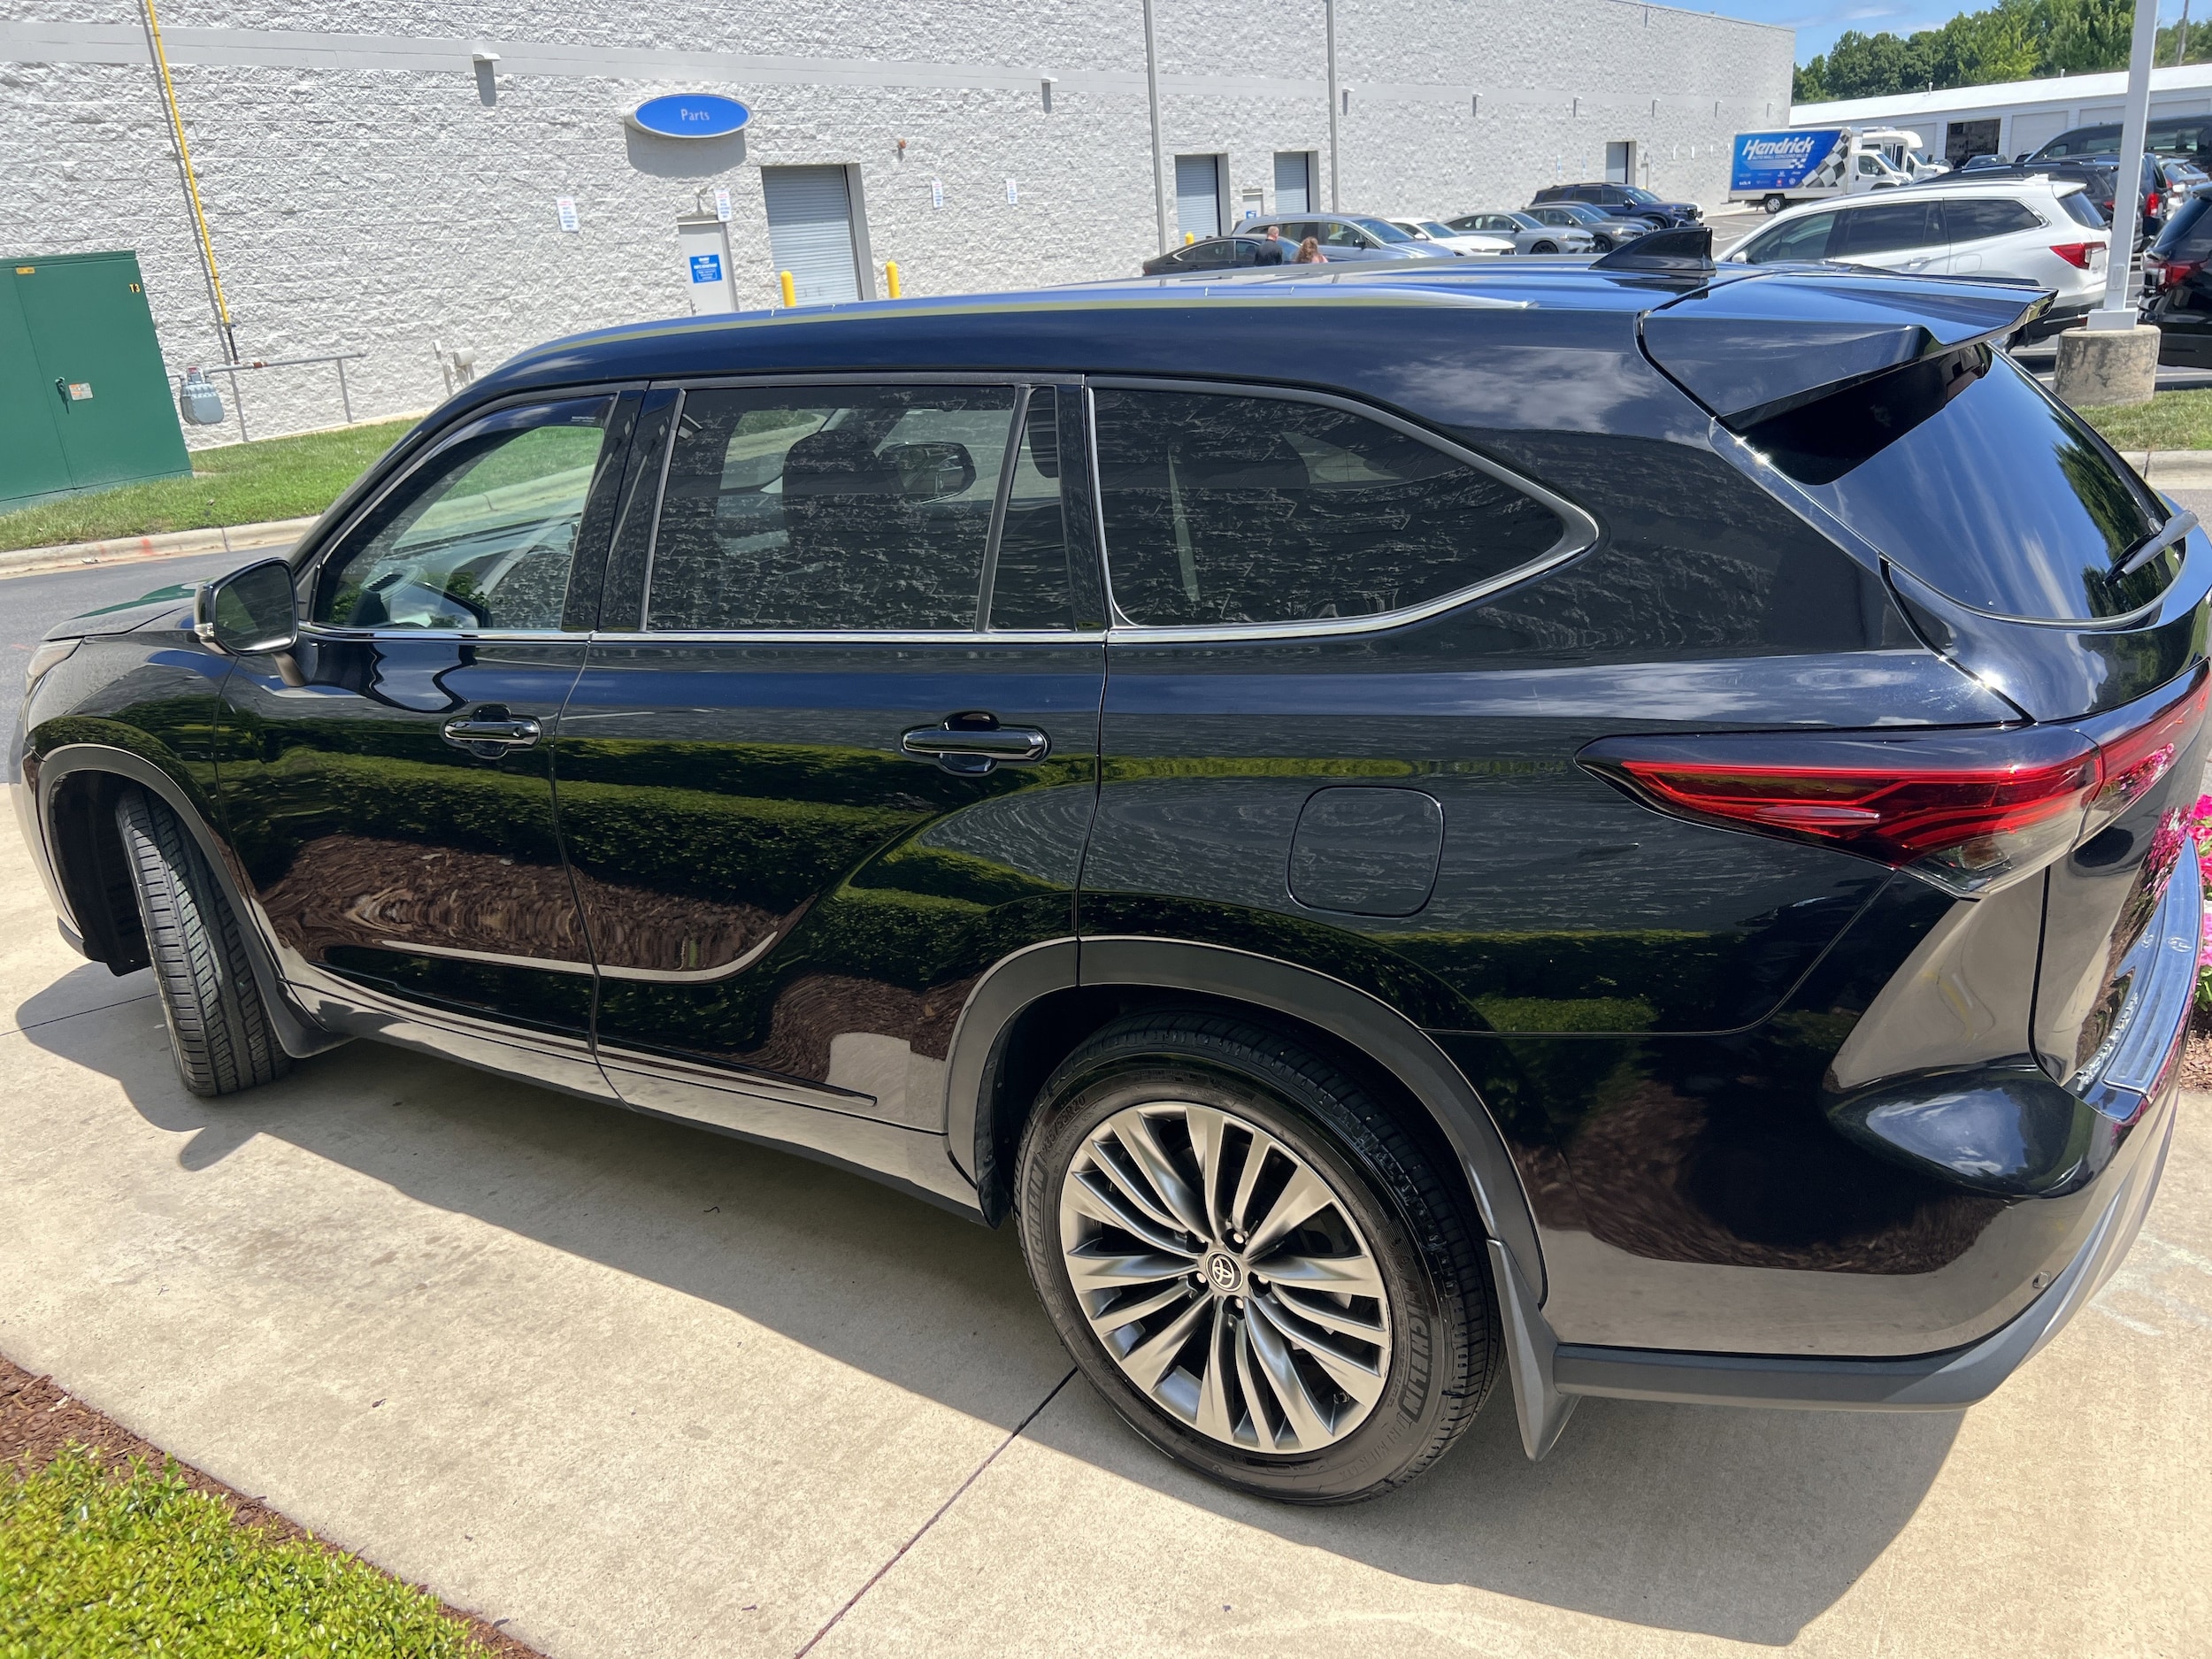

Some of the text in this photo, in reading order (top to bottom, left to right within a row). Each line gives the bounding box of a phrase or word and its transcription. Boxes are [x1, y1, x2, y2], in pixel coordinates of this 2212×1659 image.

[680, 108, 710, 121] Parts
[1741, 136, 1815, 160] Hendrick
[1026, 1163, 1055, 1289] MICHELIN
[1400, 1279, 1431, 1416] MICHELIN
